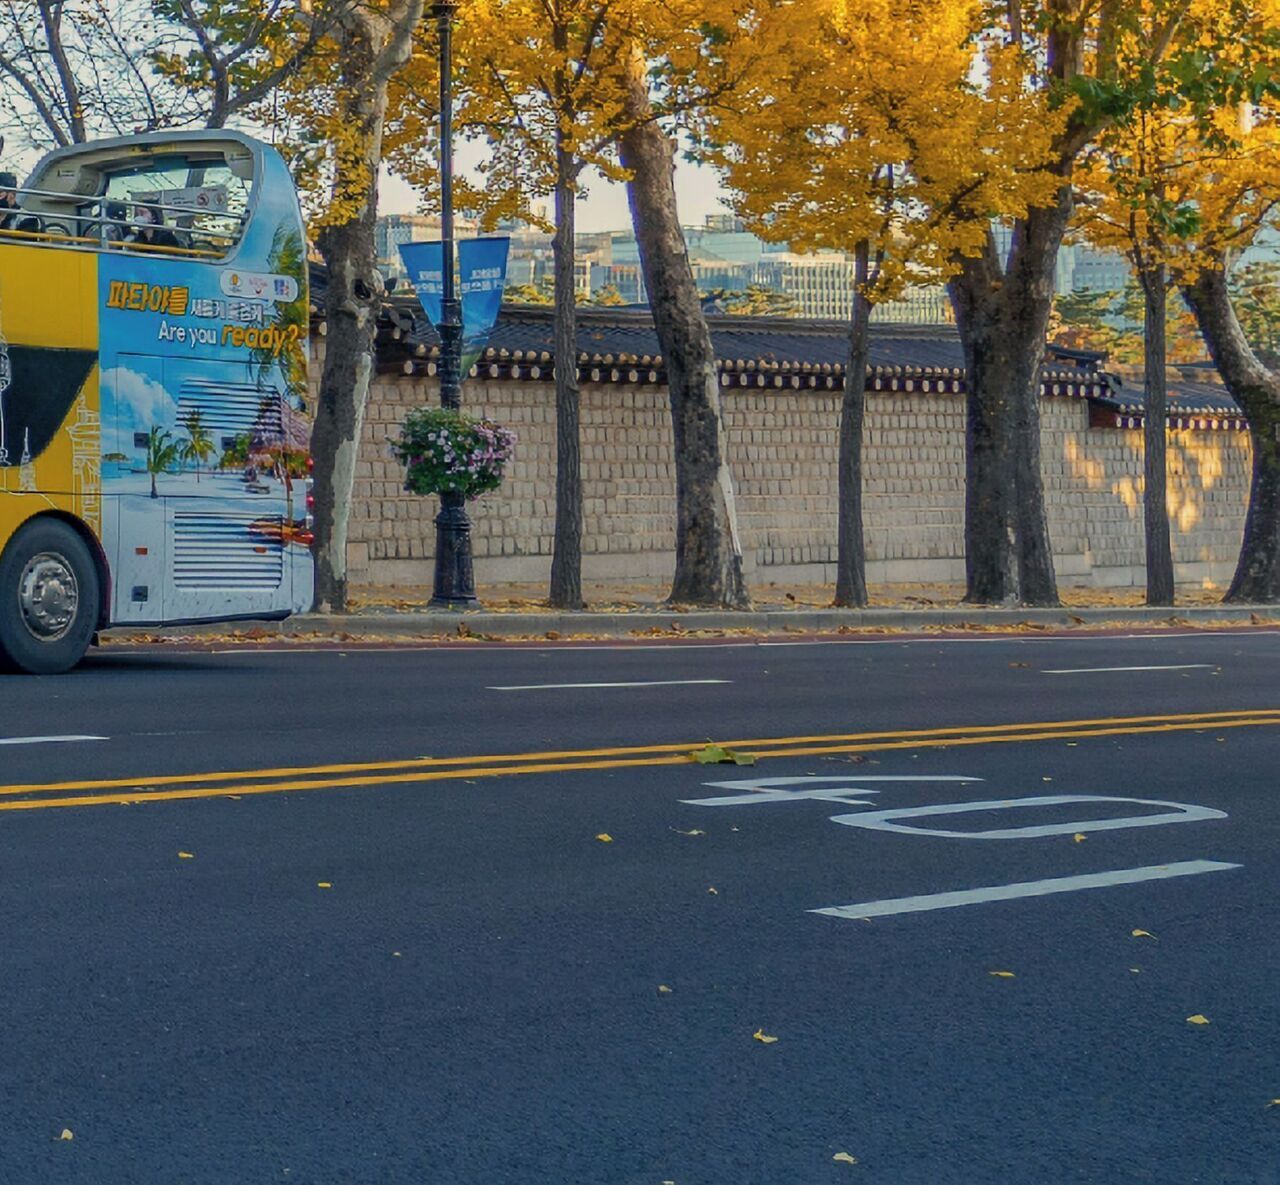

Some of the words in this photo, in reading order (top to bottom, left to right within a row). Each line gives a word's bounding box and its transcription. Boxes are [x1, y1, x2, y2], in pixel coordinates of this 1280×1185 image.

[106, 280, 189, 315] 파타야를
[158, 320, 186, 343] Are
[189, 327, 217, 349] you
[222, 324, 298, 356] ready?
